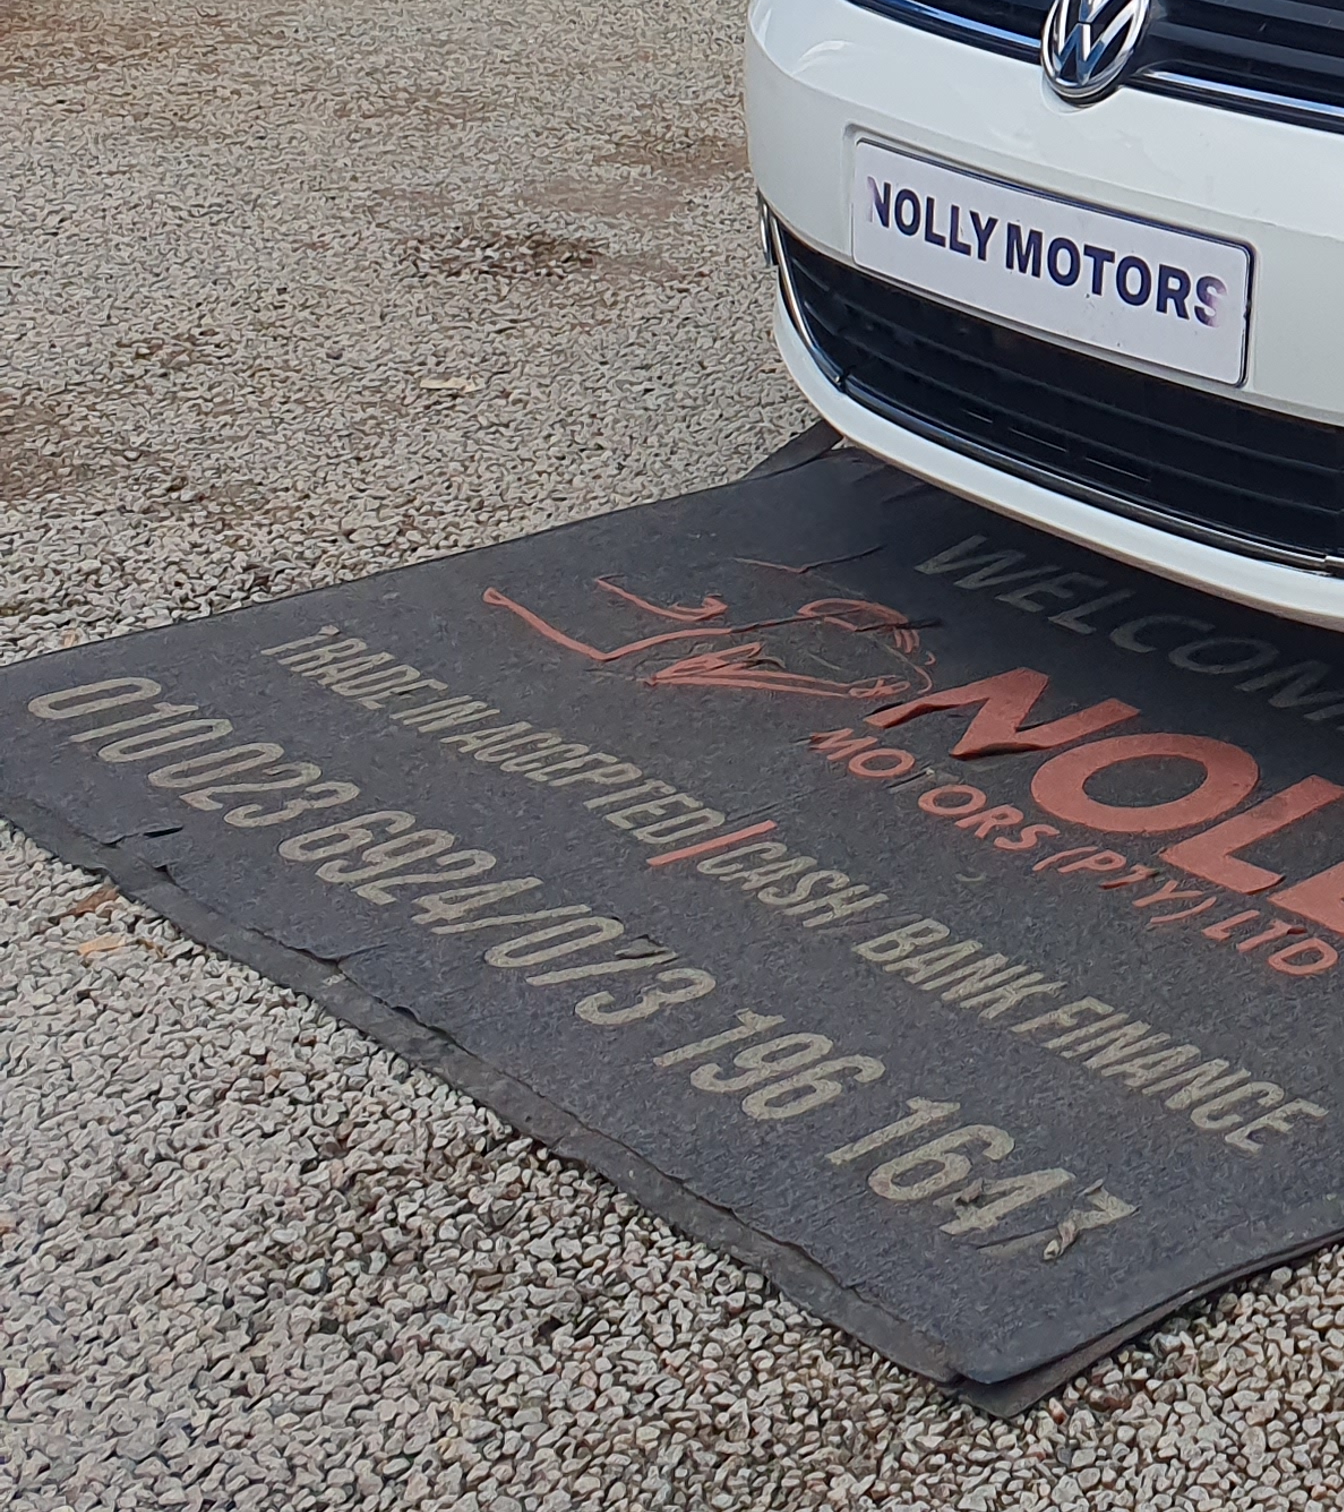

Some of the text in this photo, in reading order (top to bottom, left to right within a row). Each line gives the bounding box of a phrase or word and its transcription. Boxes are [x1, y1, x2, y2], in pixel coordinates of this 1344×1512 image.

[867, 175, 1229, 329] NOLLY MOTORS
[260, 624, 449, 710] TRADE
[389, 695, 500, 733] IN
[440, 721, 725, 844] ACCEPTED
[697, 841, 889, 928] CASH
[1033, 846, 1217, 924] (PTY)
[1202, 909, 1339, 976] LTD
[852, 918, 1067, 1019] BANK
[653, 1008, 886, 1120] 196
[1011, 997, 1329, 1154] FINANCE
